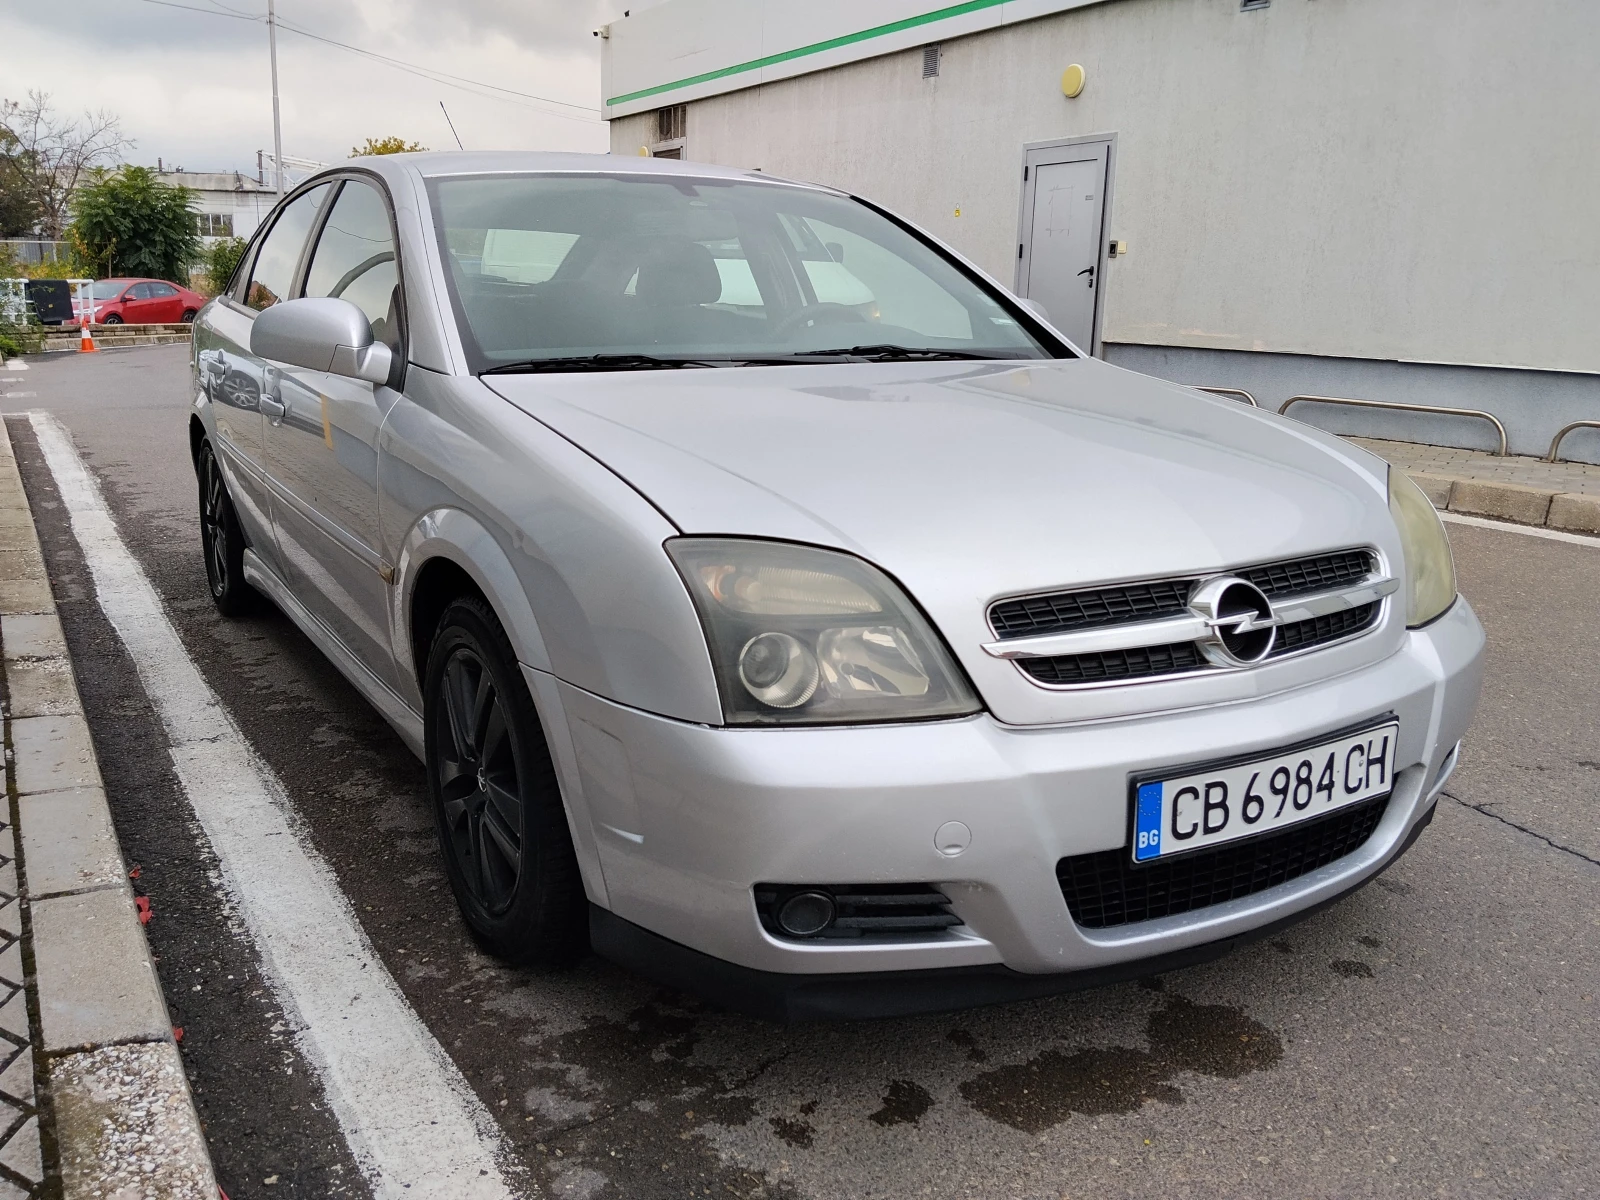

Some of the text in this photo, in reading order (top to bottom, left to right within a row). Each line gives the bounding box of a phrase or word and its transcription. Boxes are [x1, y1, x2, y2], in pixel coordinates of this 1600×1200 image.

[1171, 736, 1389, 840] CB 6984 CH
[1138, 829, 1159, 849] BG
